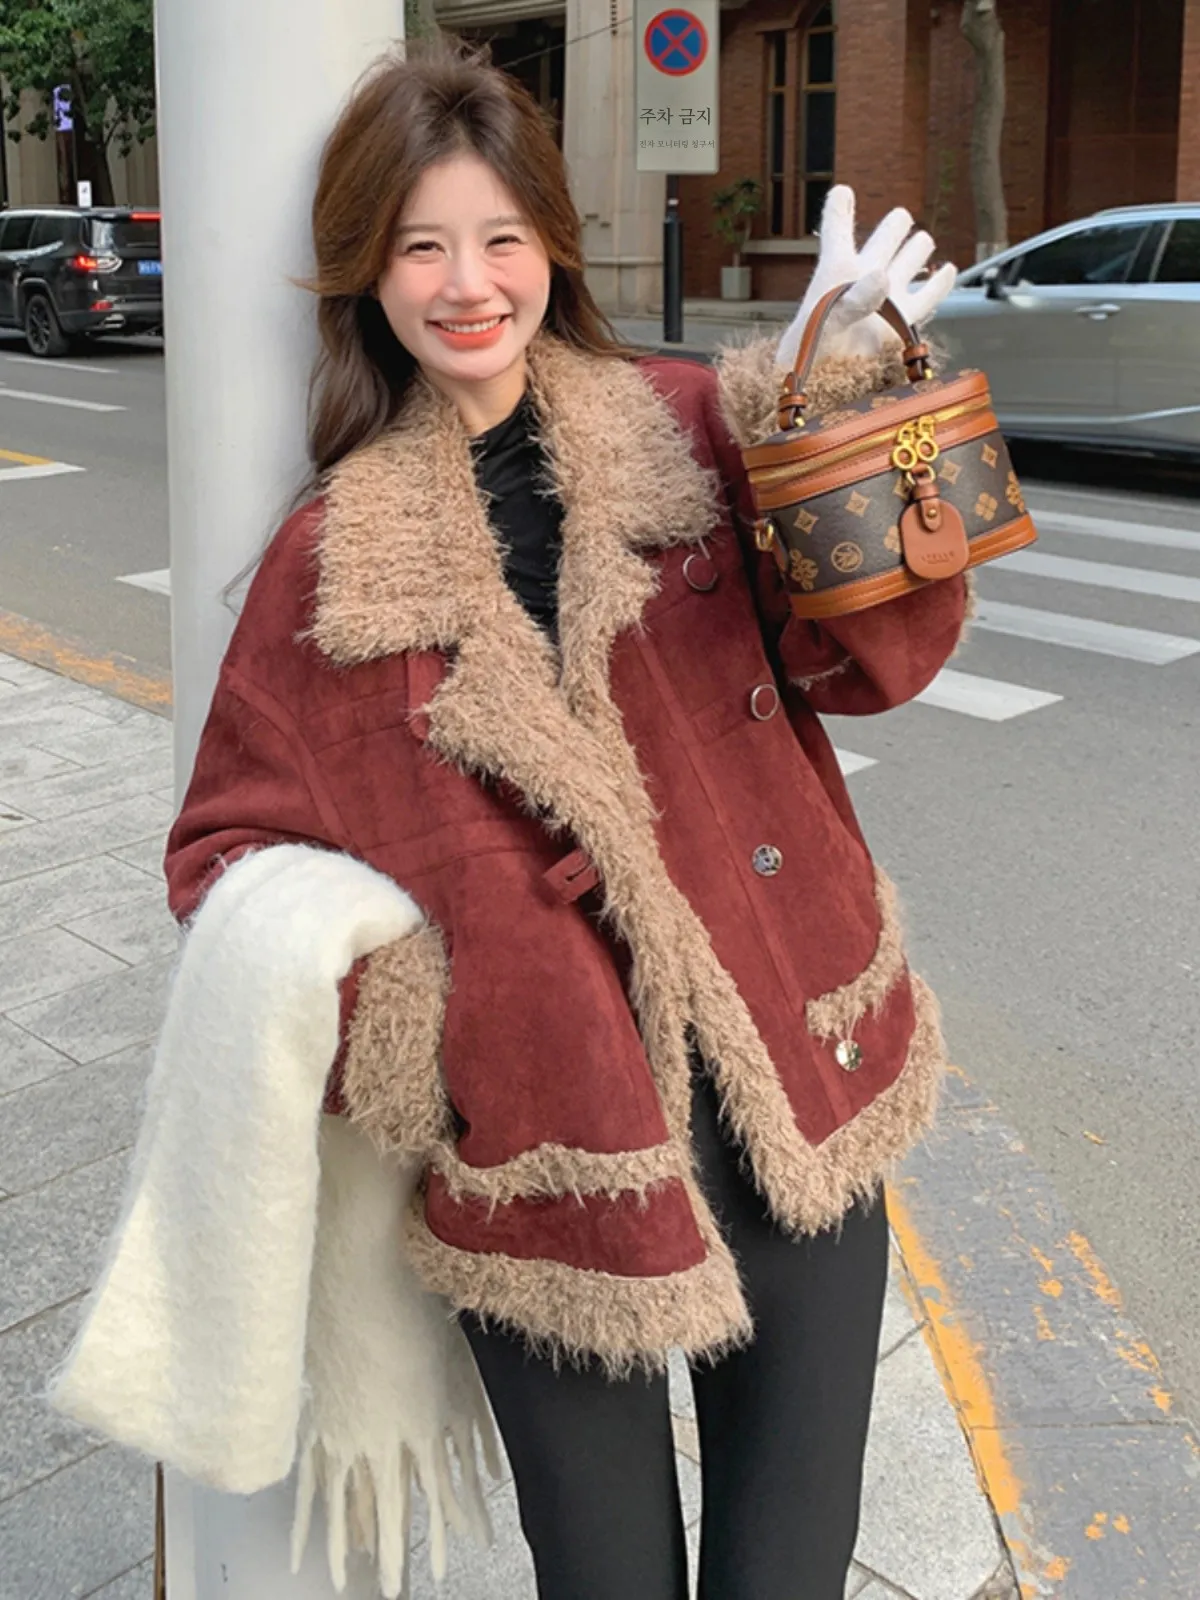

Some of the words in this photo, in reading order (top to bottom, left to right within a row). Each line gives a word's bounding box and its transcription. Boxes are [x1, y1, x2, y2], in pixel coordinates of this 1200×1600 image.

[639, 107, 674, 126] 주차
[678, 107, 711, 126] 금지
[656, 139, 689, 149] 모니터링
[691, 139, 716, 149] 청구서
